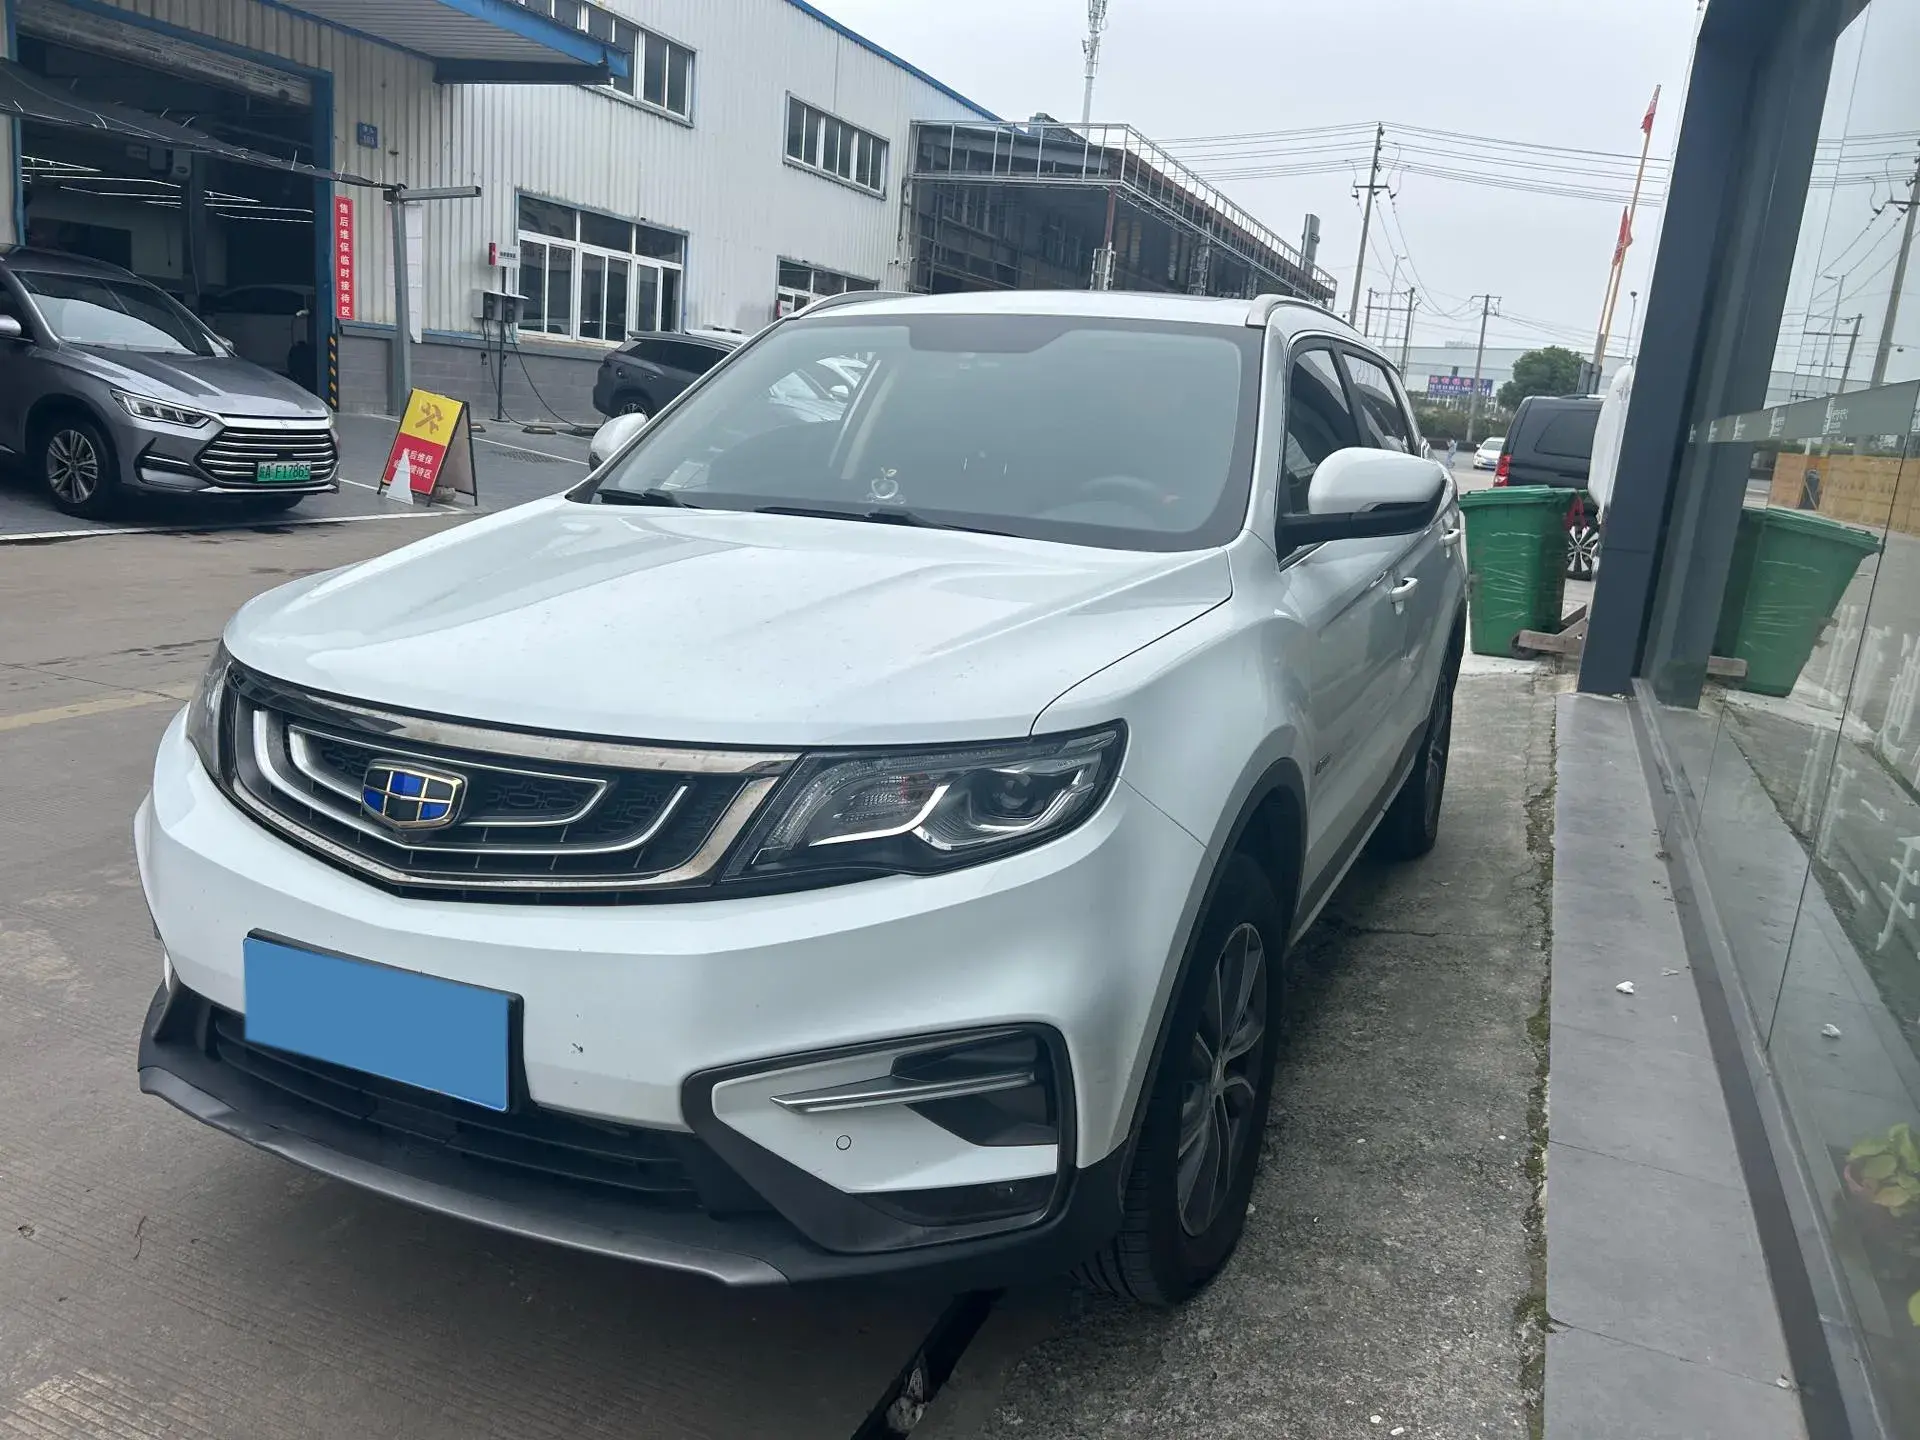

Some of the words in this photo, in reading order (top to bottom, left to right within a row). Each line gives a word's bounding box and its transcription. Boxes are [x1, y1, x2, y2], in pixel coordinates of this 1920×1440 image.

[340, 203, 351, 316] 售后维保临时接待区
